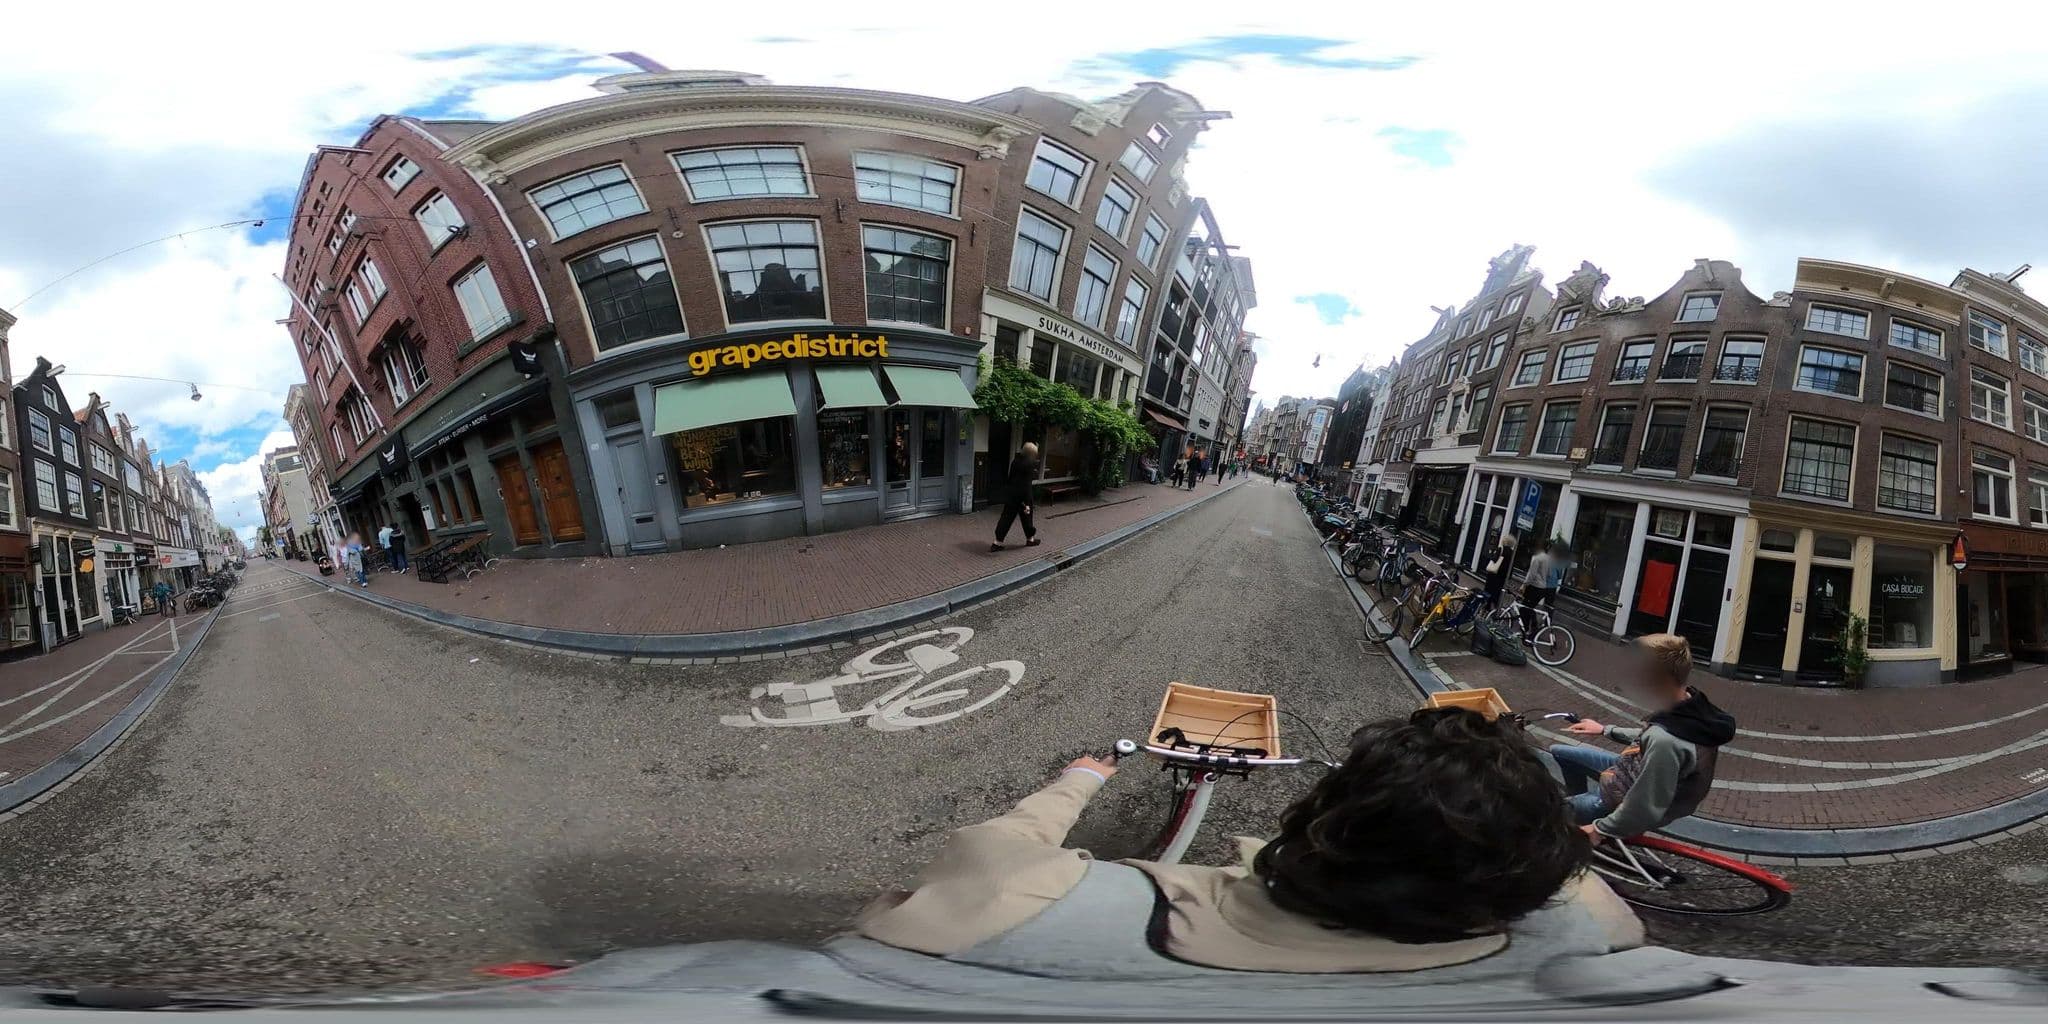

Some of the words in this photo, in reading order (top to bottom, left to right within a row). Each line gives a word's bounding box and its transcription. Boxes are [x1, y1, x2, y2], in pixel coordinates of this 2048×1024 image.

[688, 333, 889, 376] grapedistrict
[1039, 317, 1075, 340] SUKHA
[1078, 335, 1124, 364] AMSTERDAM
[1881, 583, 1900, 593] CASA
